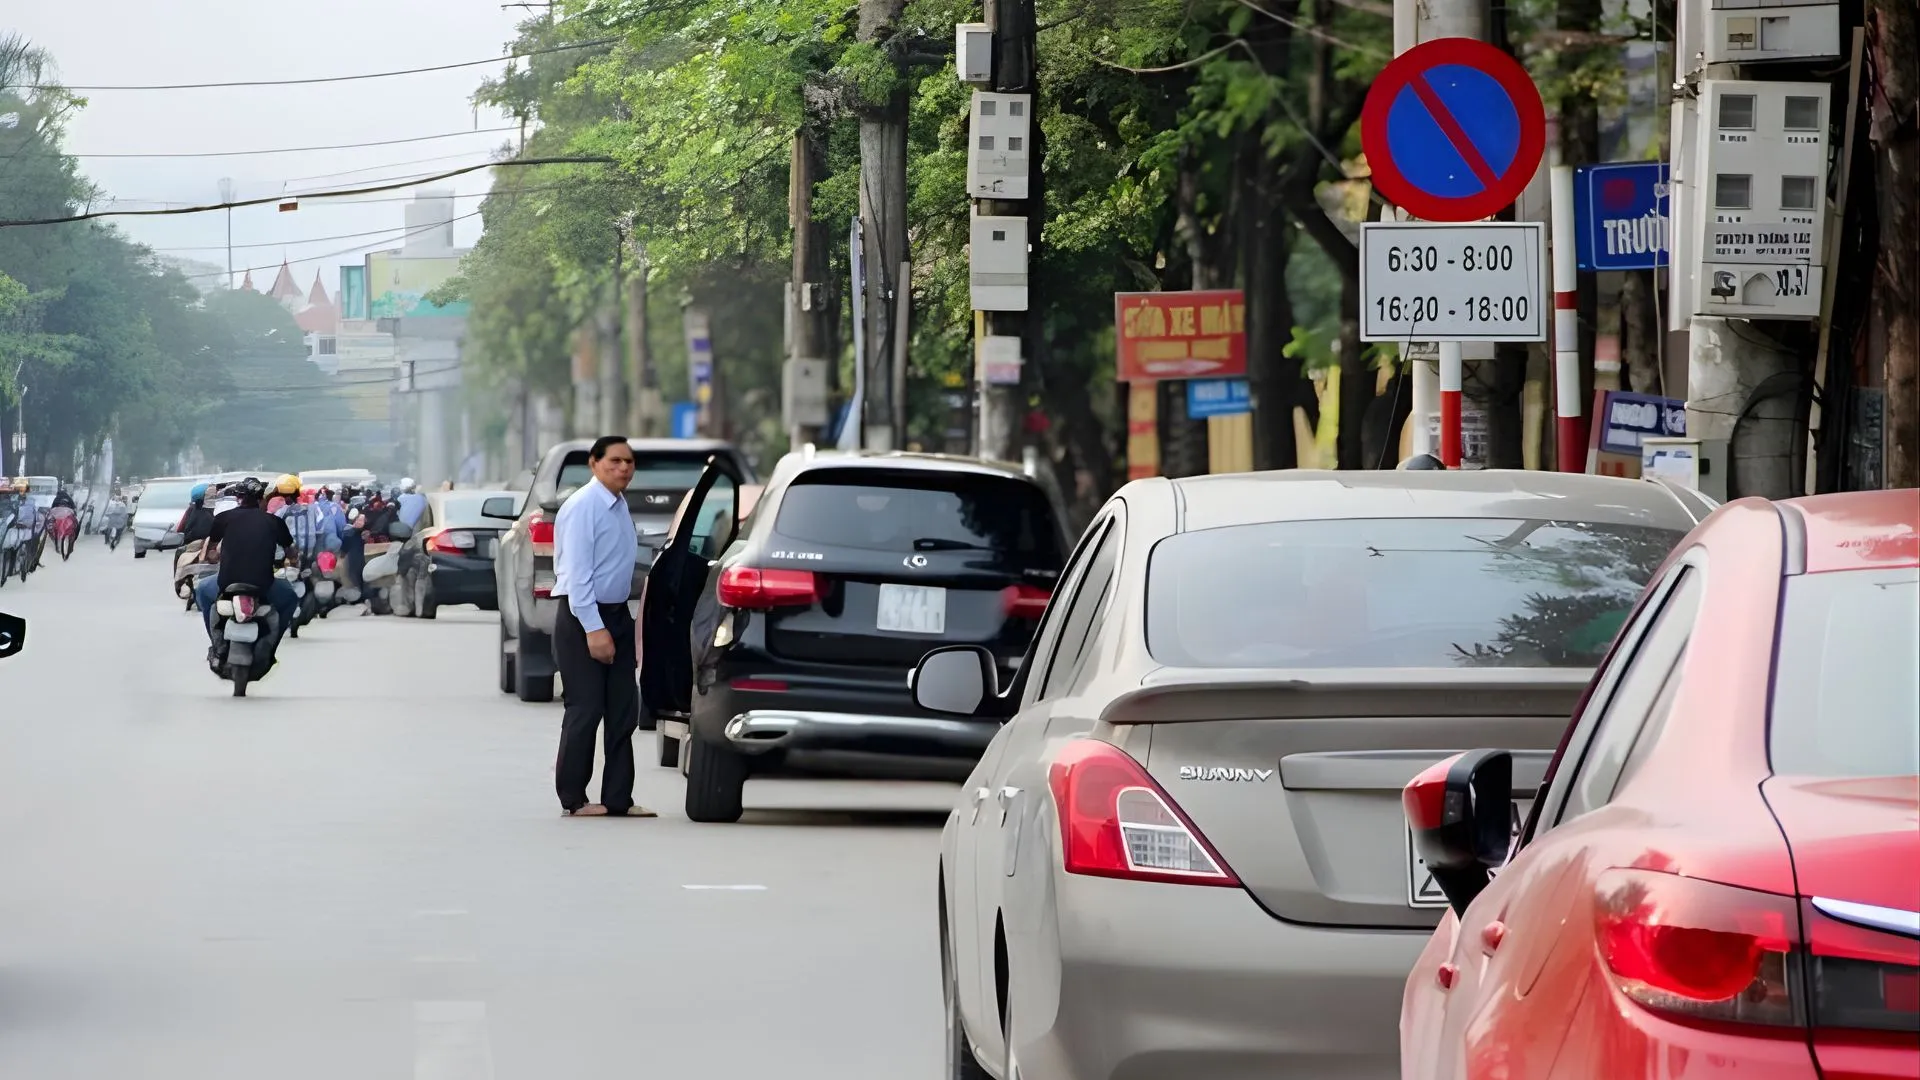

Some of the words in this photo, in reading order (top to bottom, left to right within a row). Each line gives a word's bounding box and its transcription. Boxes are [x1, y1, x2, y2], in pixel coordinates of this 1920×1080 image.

[1388, 246, 1438, 272] 6:30
[1462, 245, 1513, 271] 8:00
[1376, 296, 1439, 322] 16:30
[1464, 296, 1528, 322] 18:00
[1180, 765, 1273, 782] SUNNY
